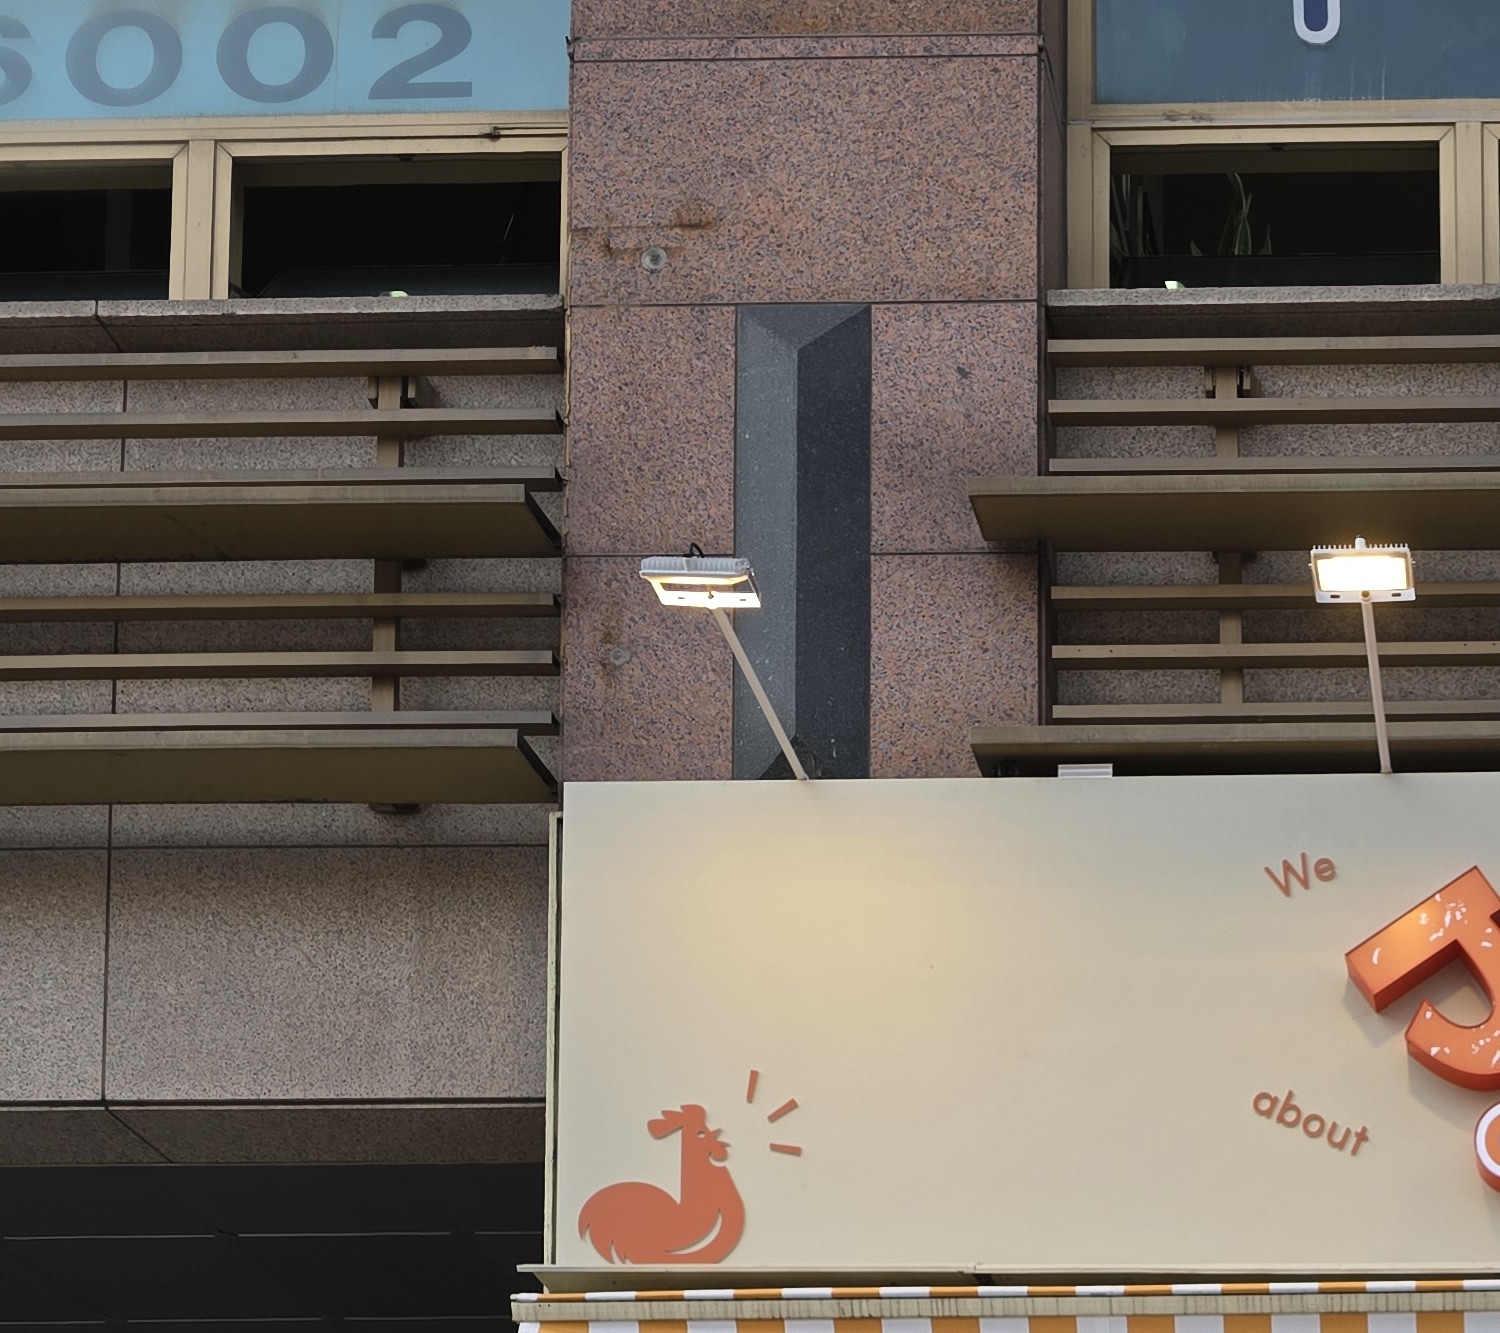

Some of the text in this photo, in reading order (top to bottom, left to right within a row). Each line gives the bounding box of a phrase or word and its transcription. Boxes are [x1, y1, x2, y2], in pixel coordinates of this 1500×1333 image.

[0, 3, 473, 107] 002
[1263, 852, 1337, 899] We
[1252, 1089, 1370, 1157] about
